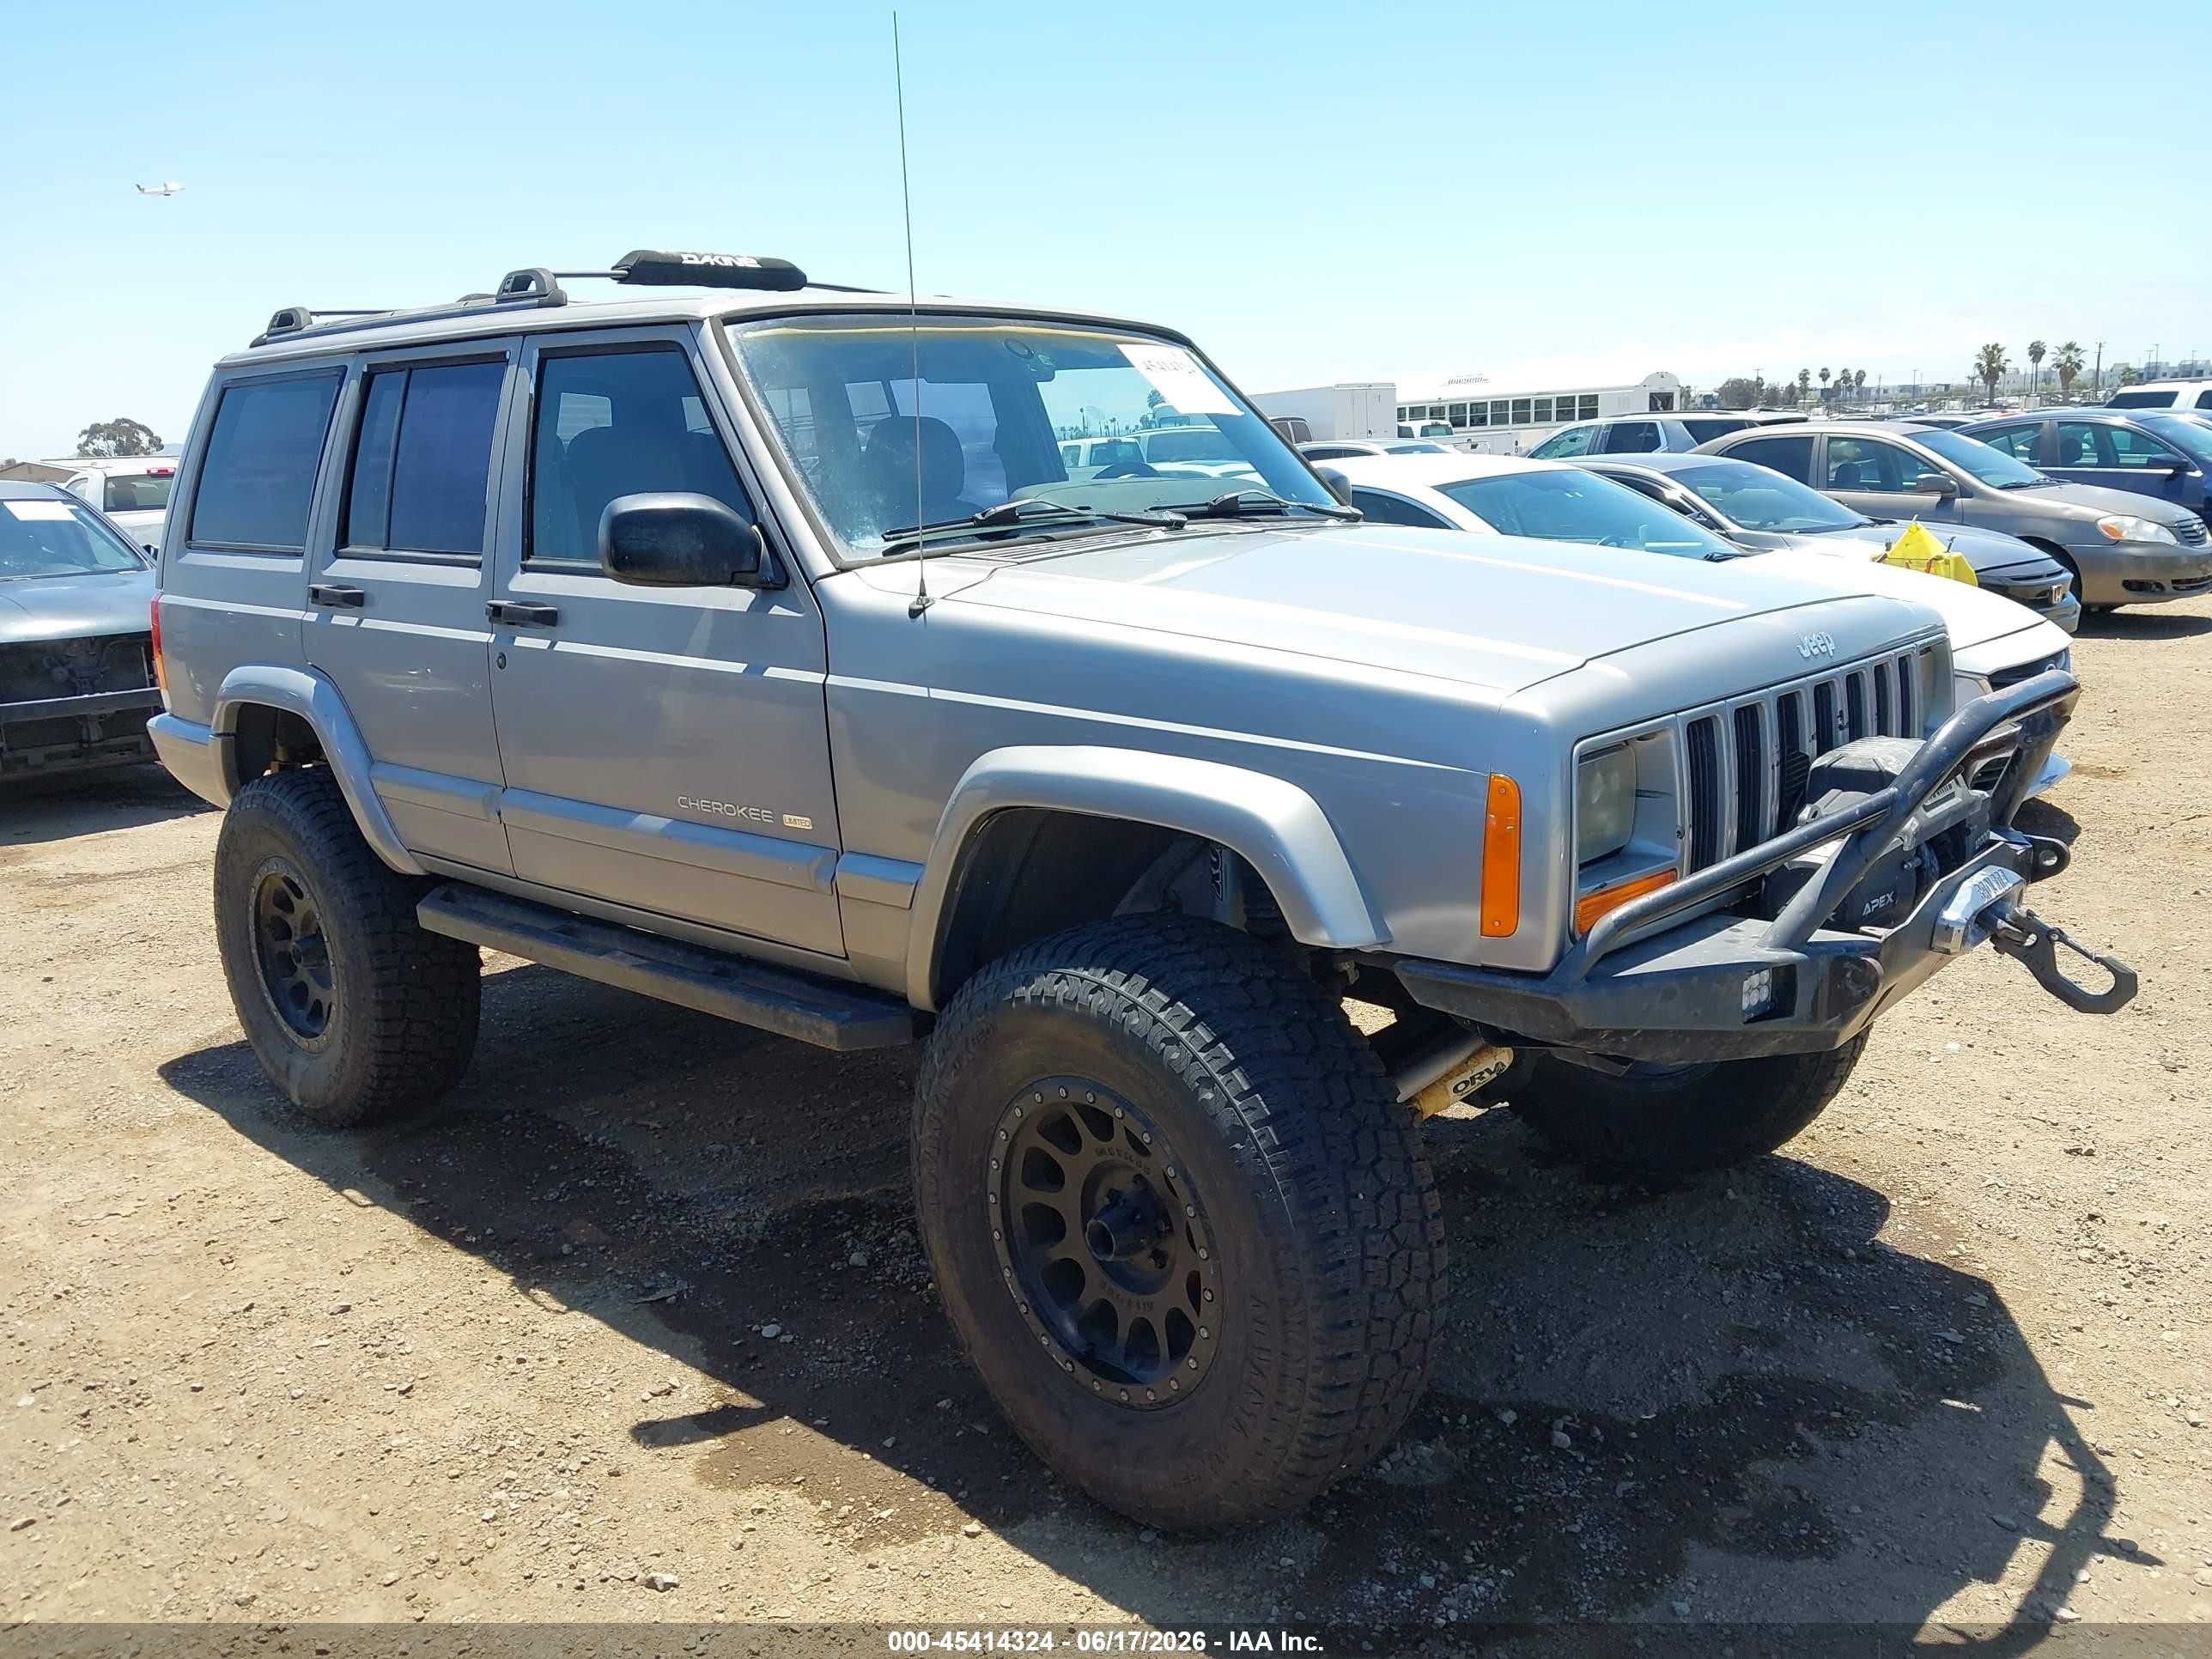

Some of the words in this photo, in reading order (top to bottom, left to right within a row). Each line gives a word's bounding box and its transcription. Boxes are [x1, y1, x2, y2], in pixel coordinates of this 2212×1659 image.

[681, 253, 762, 268] DAKINE
[1796, 632, 1836, 659] Jeep
[677, 795, 775, 823] CHEROKEE
[1862, 890, 1895, 917] APEX
